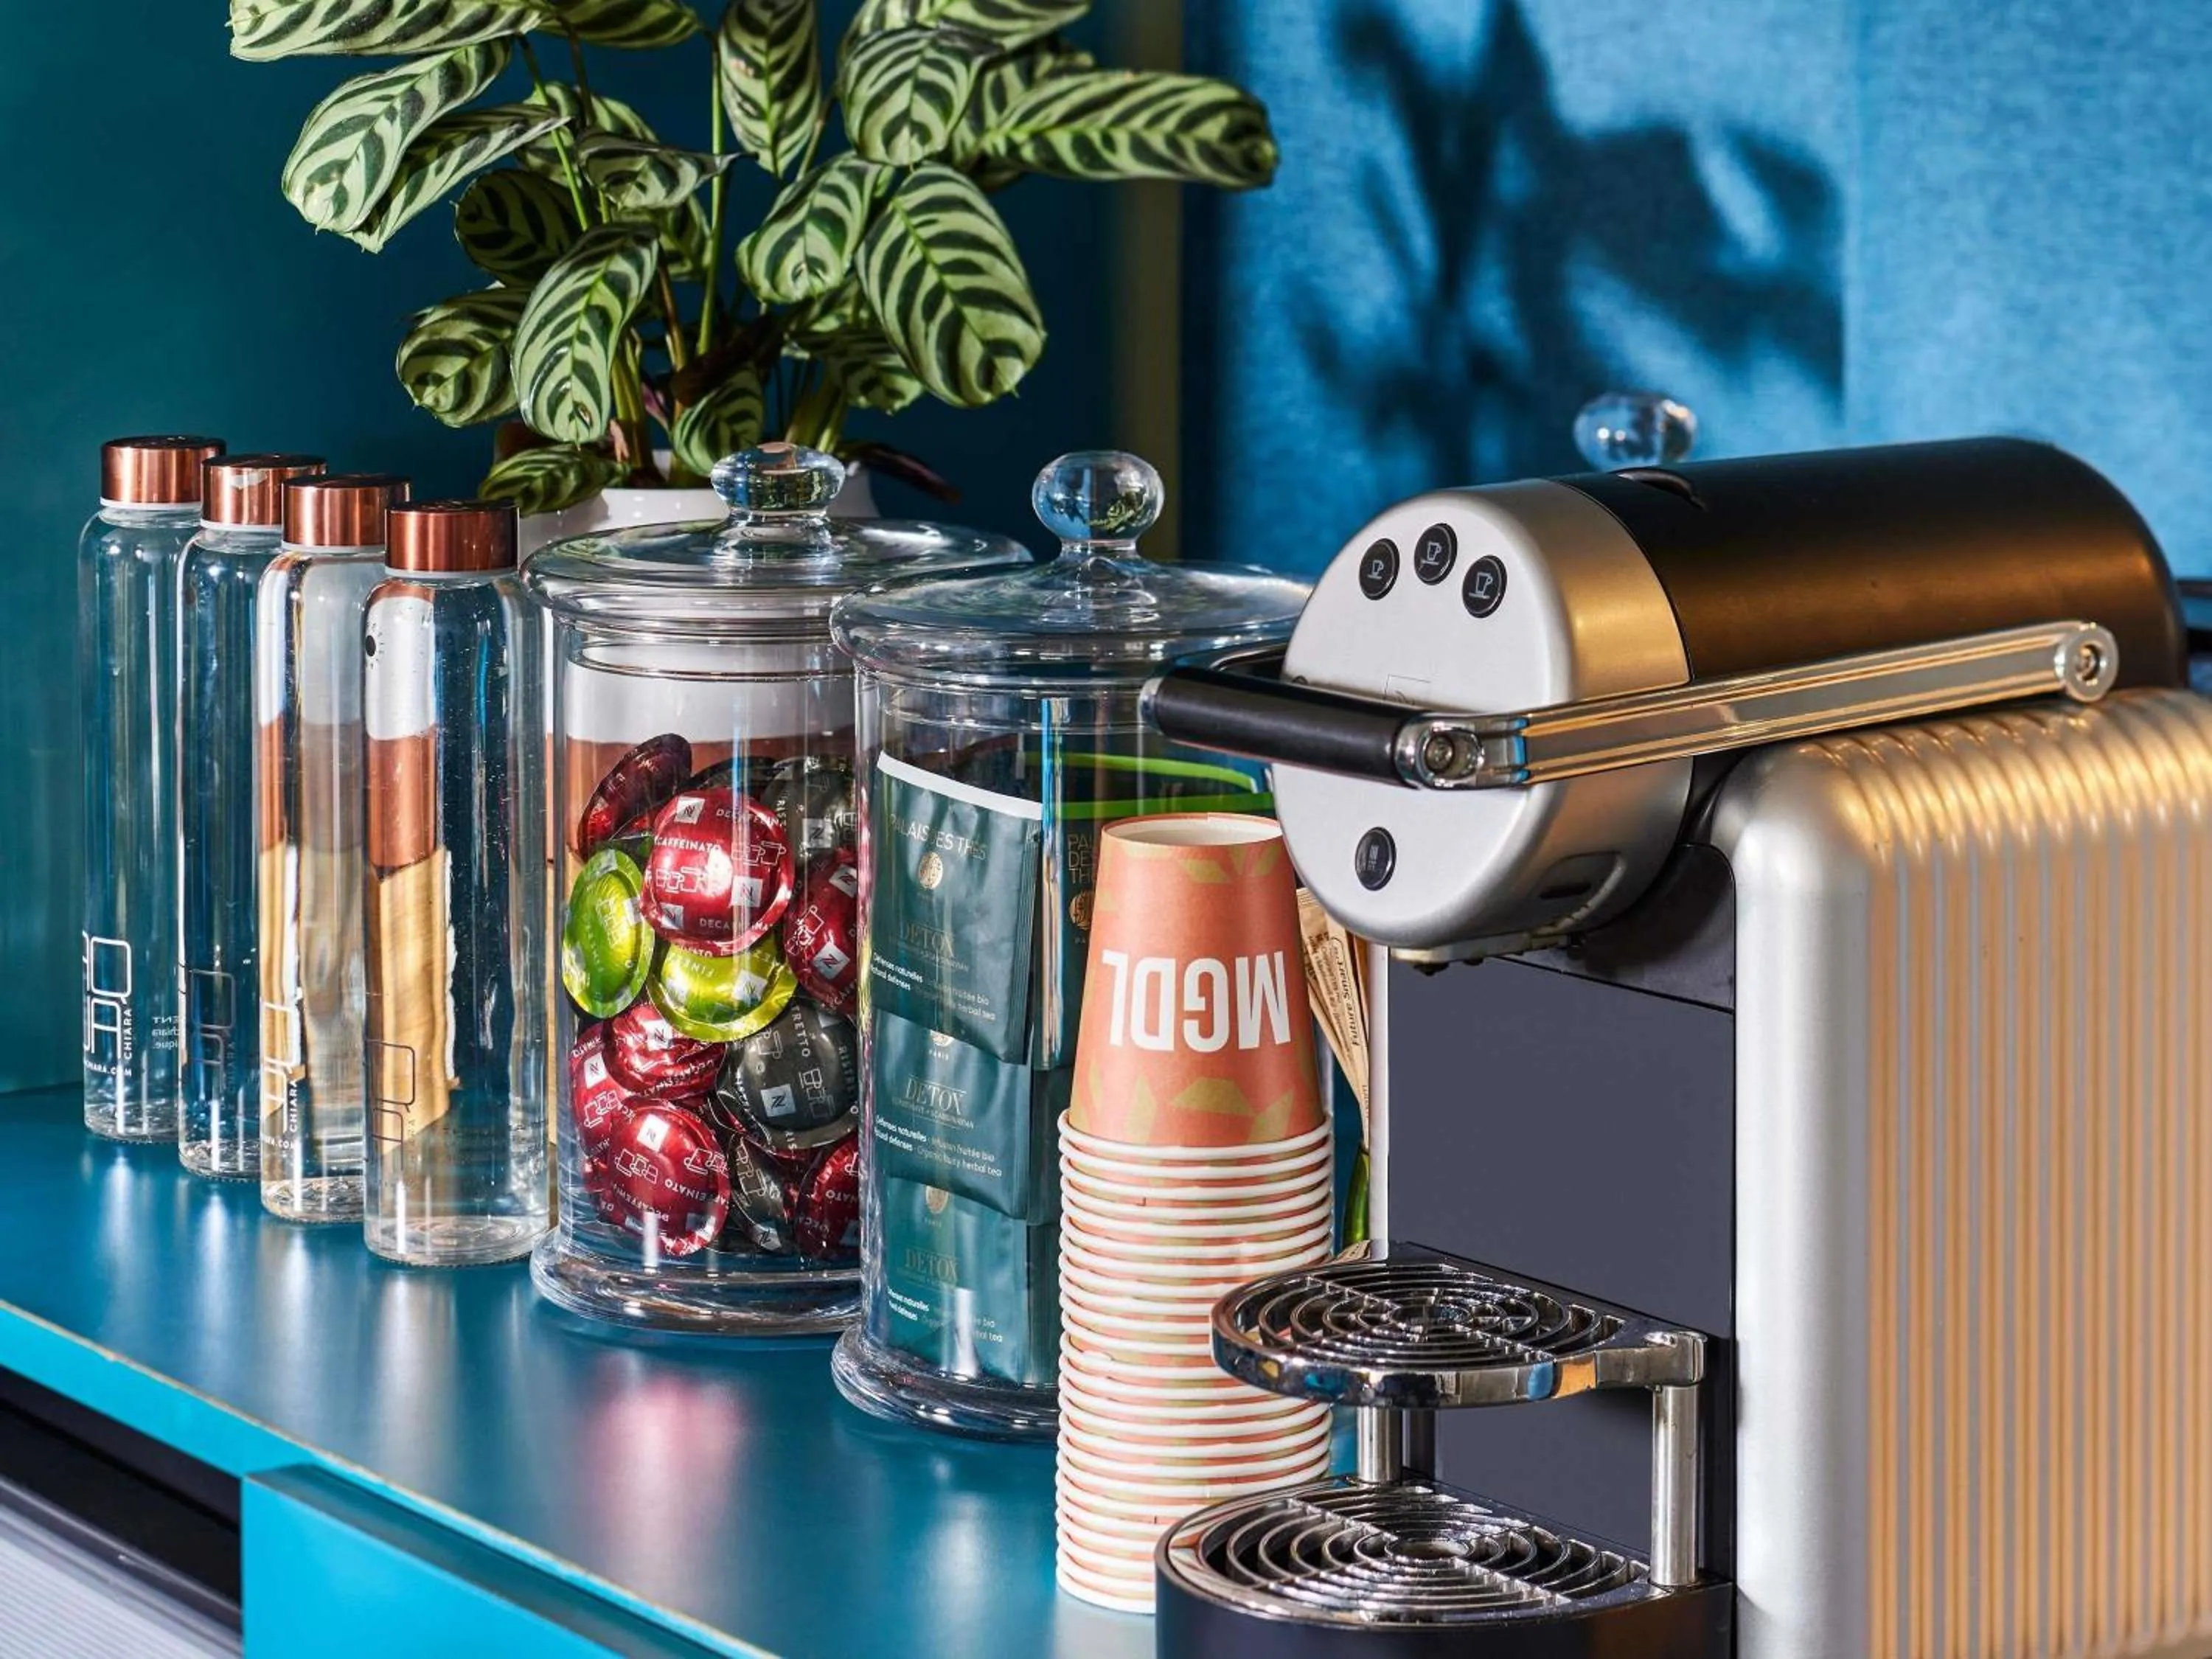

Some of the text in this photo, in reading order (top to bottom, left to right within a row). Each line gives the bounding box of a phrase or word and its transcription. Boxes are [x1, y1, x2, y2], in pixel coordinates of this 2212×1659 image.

[1102, 950, 1290, 1052] MGDL
[123, 1008, 132, 1060] CHIARA
[905, 1077, 965, 1116] DETOX
[905, 1248, 958, 1285] DETOX
